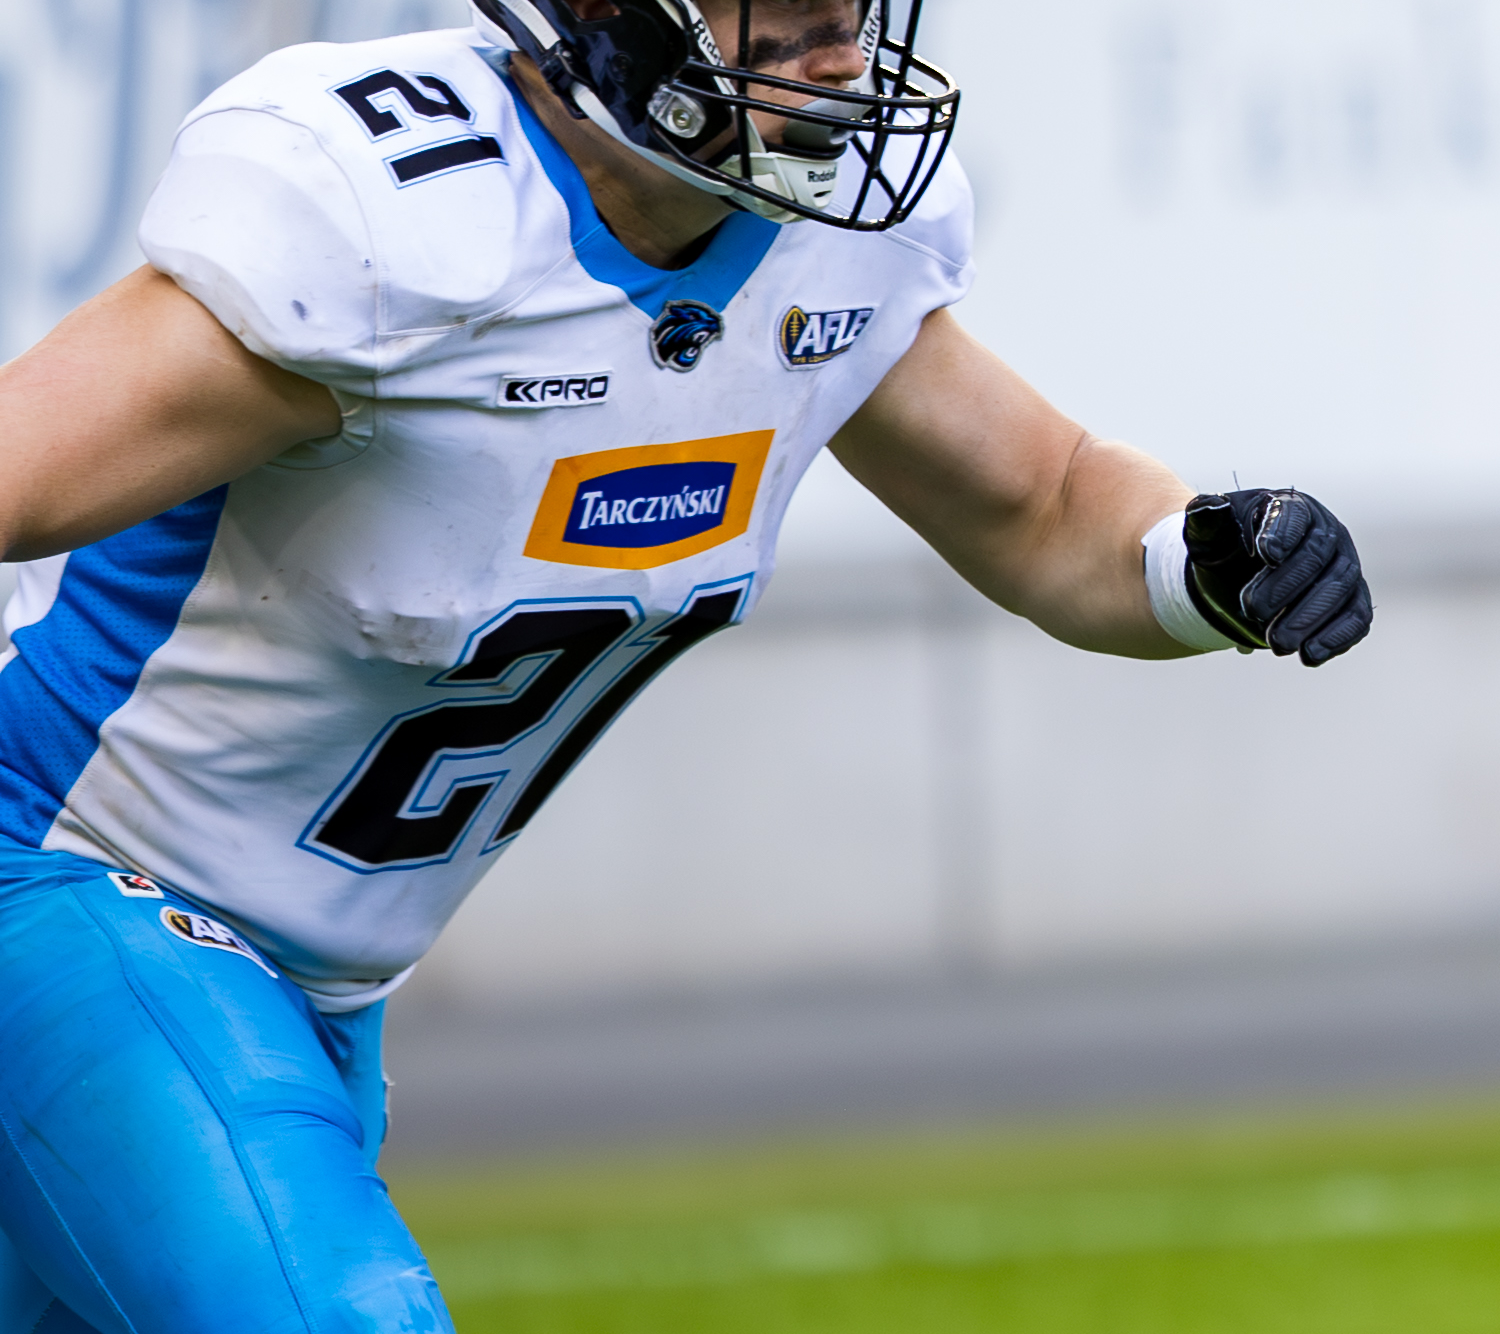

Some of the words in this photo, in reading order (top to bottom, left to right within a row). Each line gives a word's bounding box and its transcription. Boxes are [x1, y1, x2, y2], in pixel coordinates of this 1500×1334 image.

[328, 66, 509, 189] 21
[578, 484, 726, 531] TARCZYŃSKI
[295, 571, 756, 875] 21
